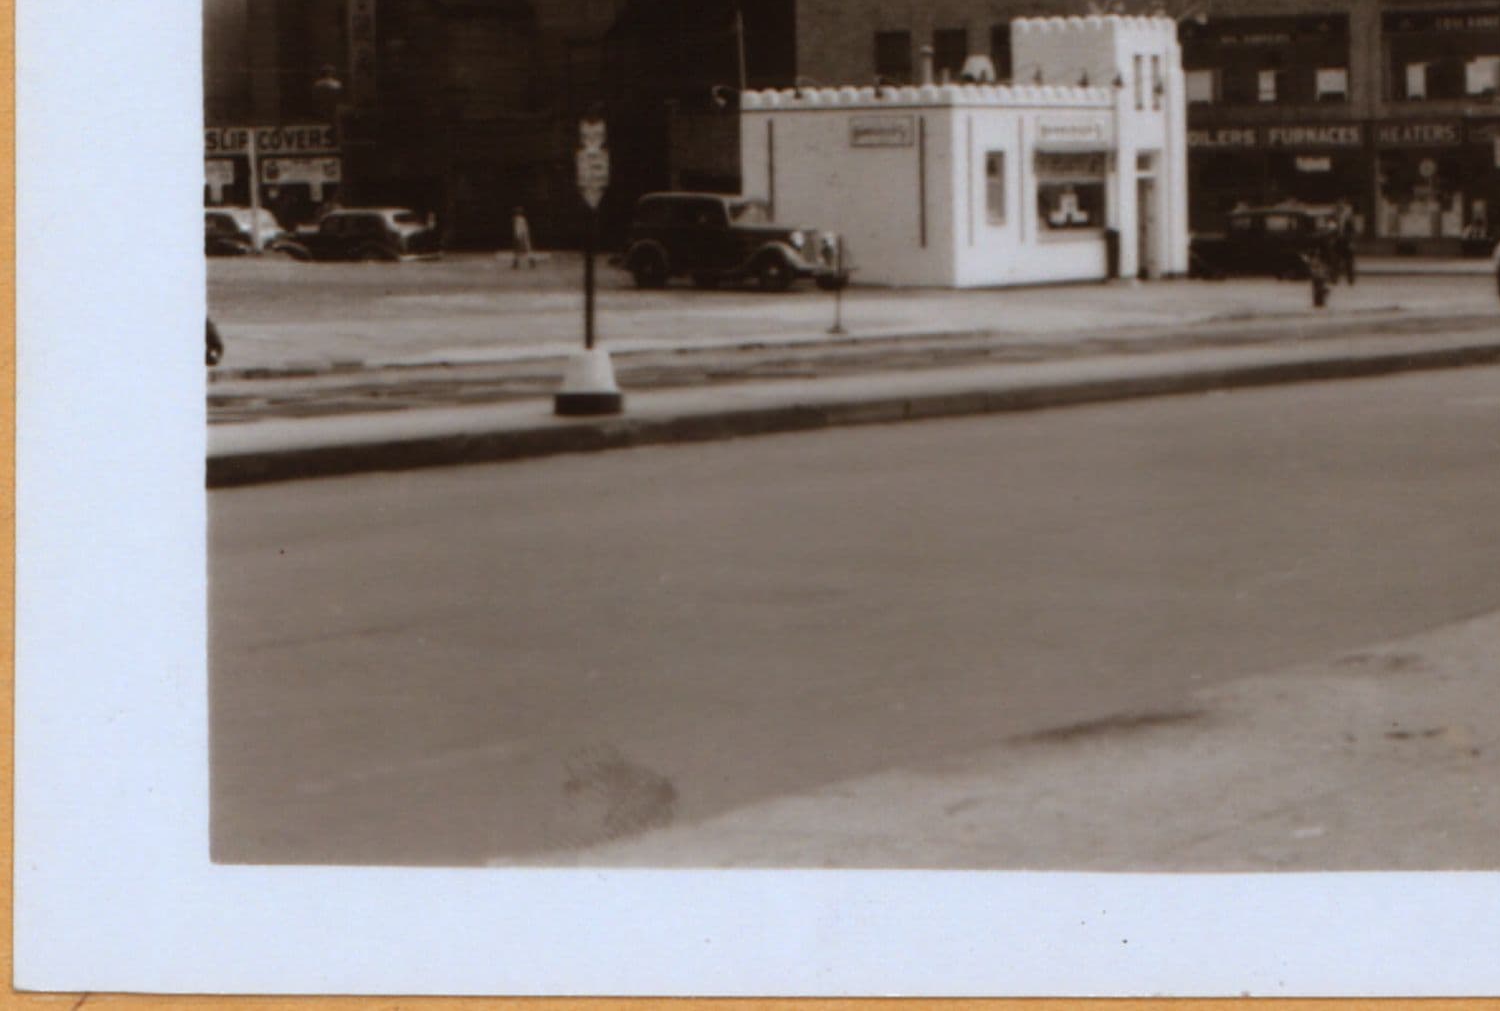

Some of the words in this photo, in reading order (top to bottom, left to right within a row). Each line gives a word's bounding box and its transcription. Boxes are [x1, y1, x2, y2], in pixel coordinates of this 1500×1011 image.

[258, 130, 334, 150] COVERS
[1267, 127, 1360, 146] FURNACES
[1377, 125, 1453, 144] HEATERS
